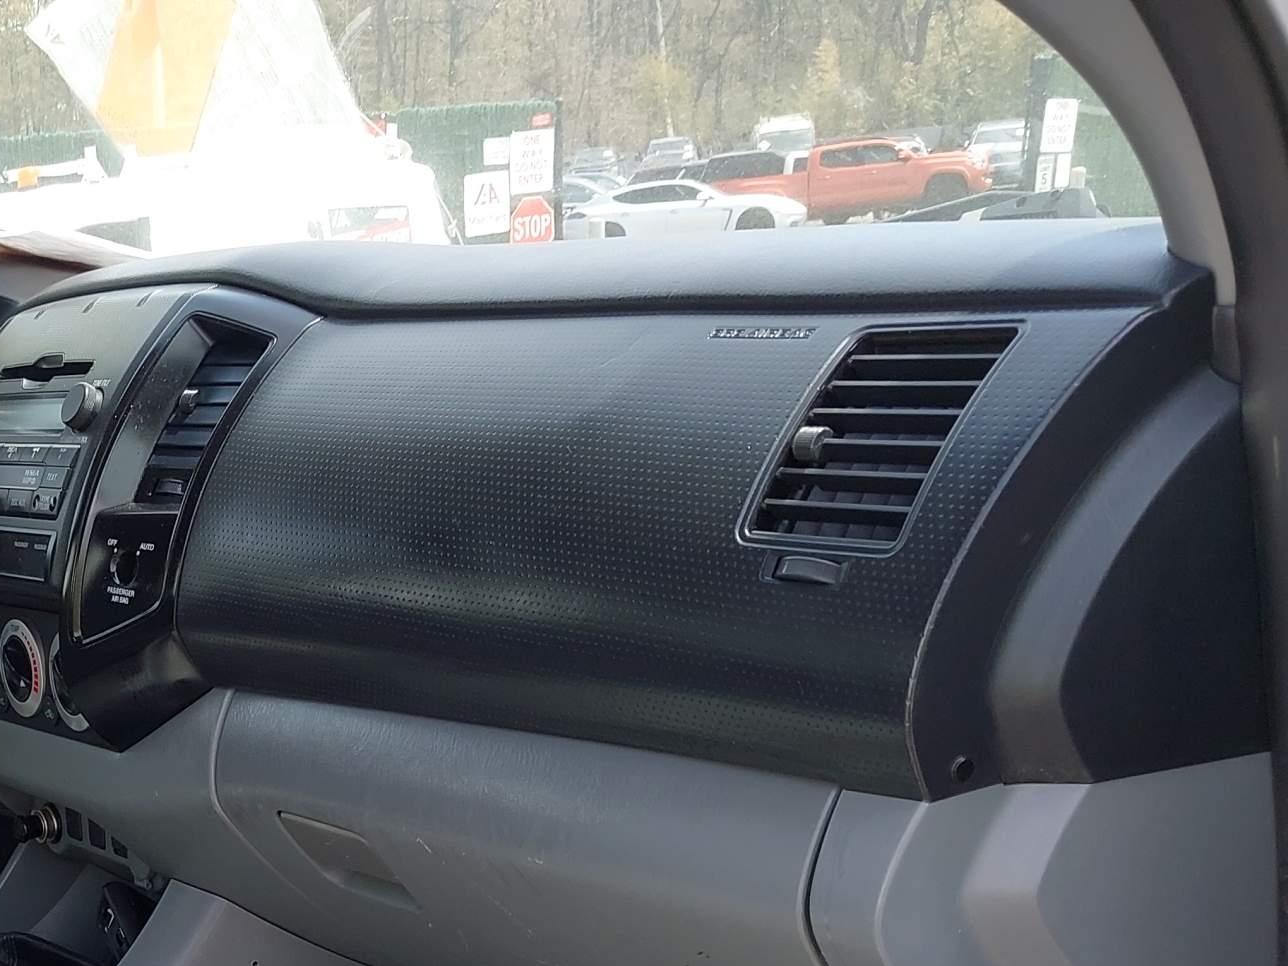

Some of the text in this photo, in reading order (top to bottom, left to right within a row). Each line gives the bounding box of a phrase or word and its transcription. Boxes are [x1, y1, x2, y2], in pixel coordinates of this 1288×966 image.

[523, 134, 541, 146] ONE
[522, 148, 543, 160] WAY
[518, 173, 544, 185] ENTER
[513, 212, 552, 241] STOP
[107, 538, 118, 546] OFF
[139, 542, 155, 551] AUTO
[106, 586, 135, 598] PASSENGER
